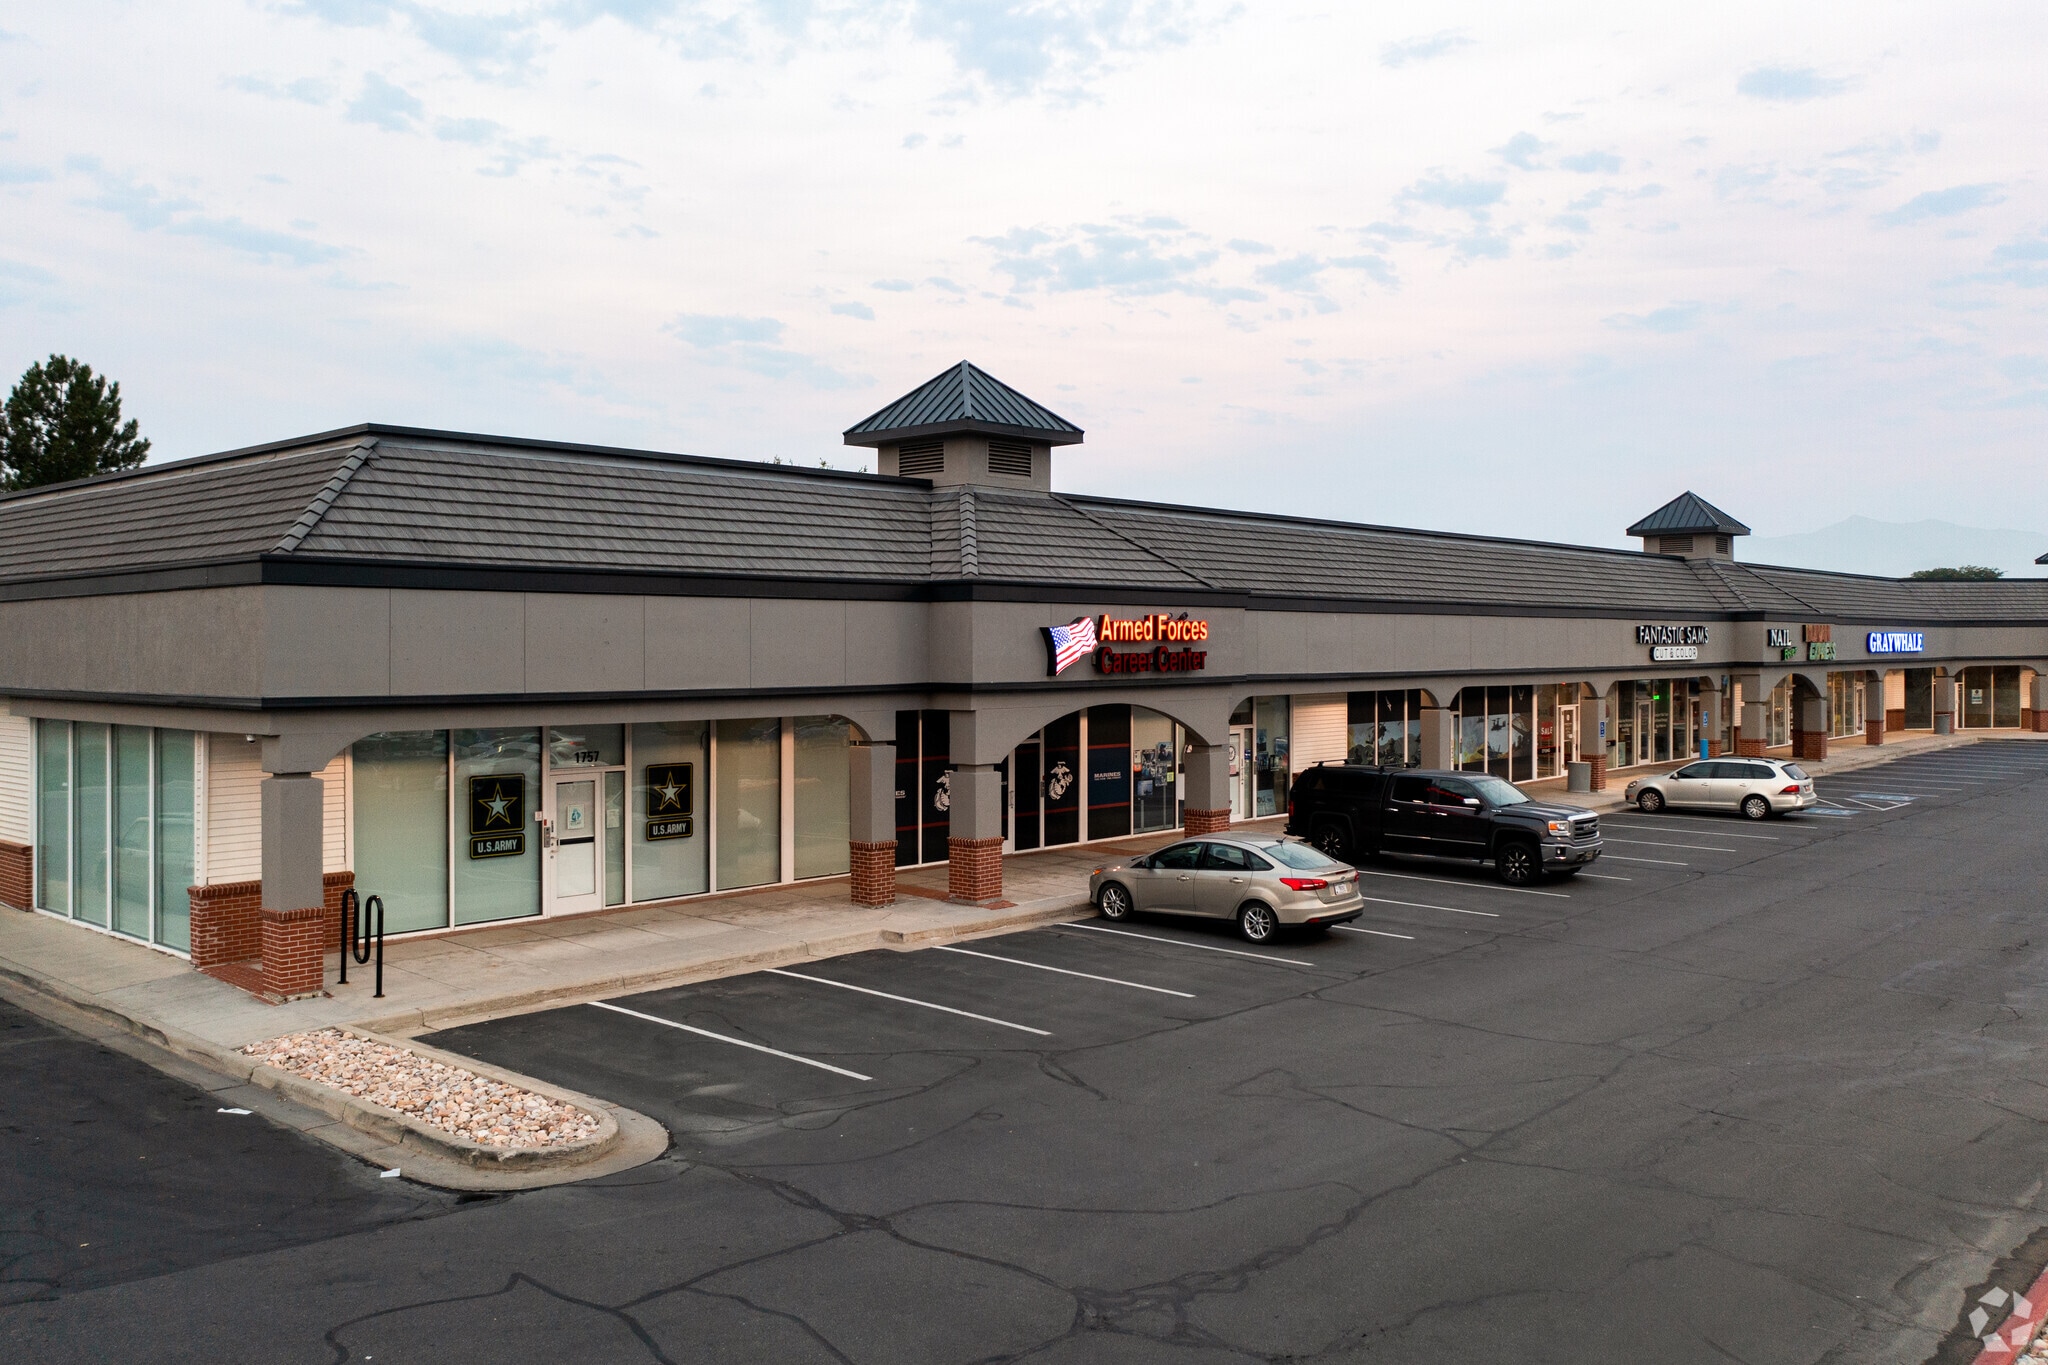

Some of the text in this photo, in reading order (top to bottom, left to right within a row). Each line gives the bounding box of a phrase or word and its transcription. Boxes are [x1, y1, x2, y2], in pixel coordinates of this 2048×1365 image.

[1099, 614, 1209, 641] Armed Forces
[1639, 626, 1709, 644] FANTASTIC SAMS
[1770, 629, 1792, 646] NAIL
[1869, 632, 1923, 653] GRAYWHALE
[1100, 645, 1208, 674] Career Center
[1655, 648, 1668, 659] CUT
[1676, 648, 1697, 659] COLOR
[574, 750, 600, 764] 1757
[1094, 771, 1121, 779] MARINES
